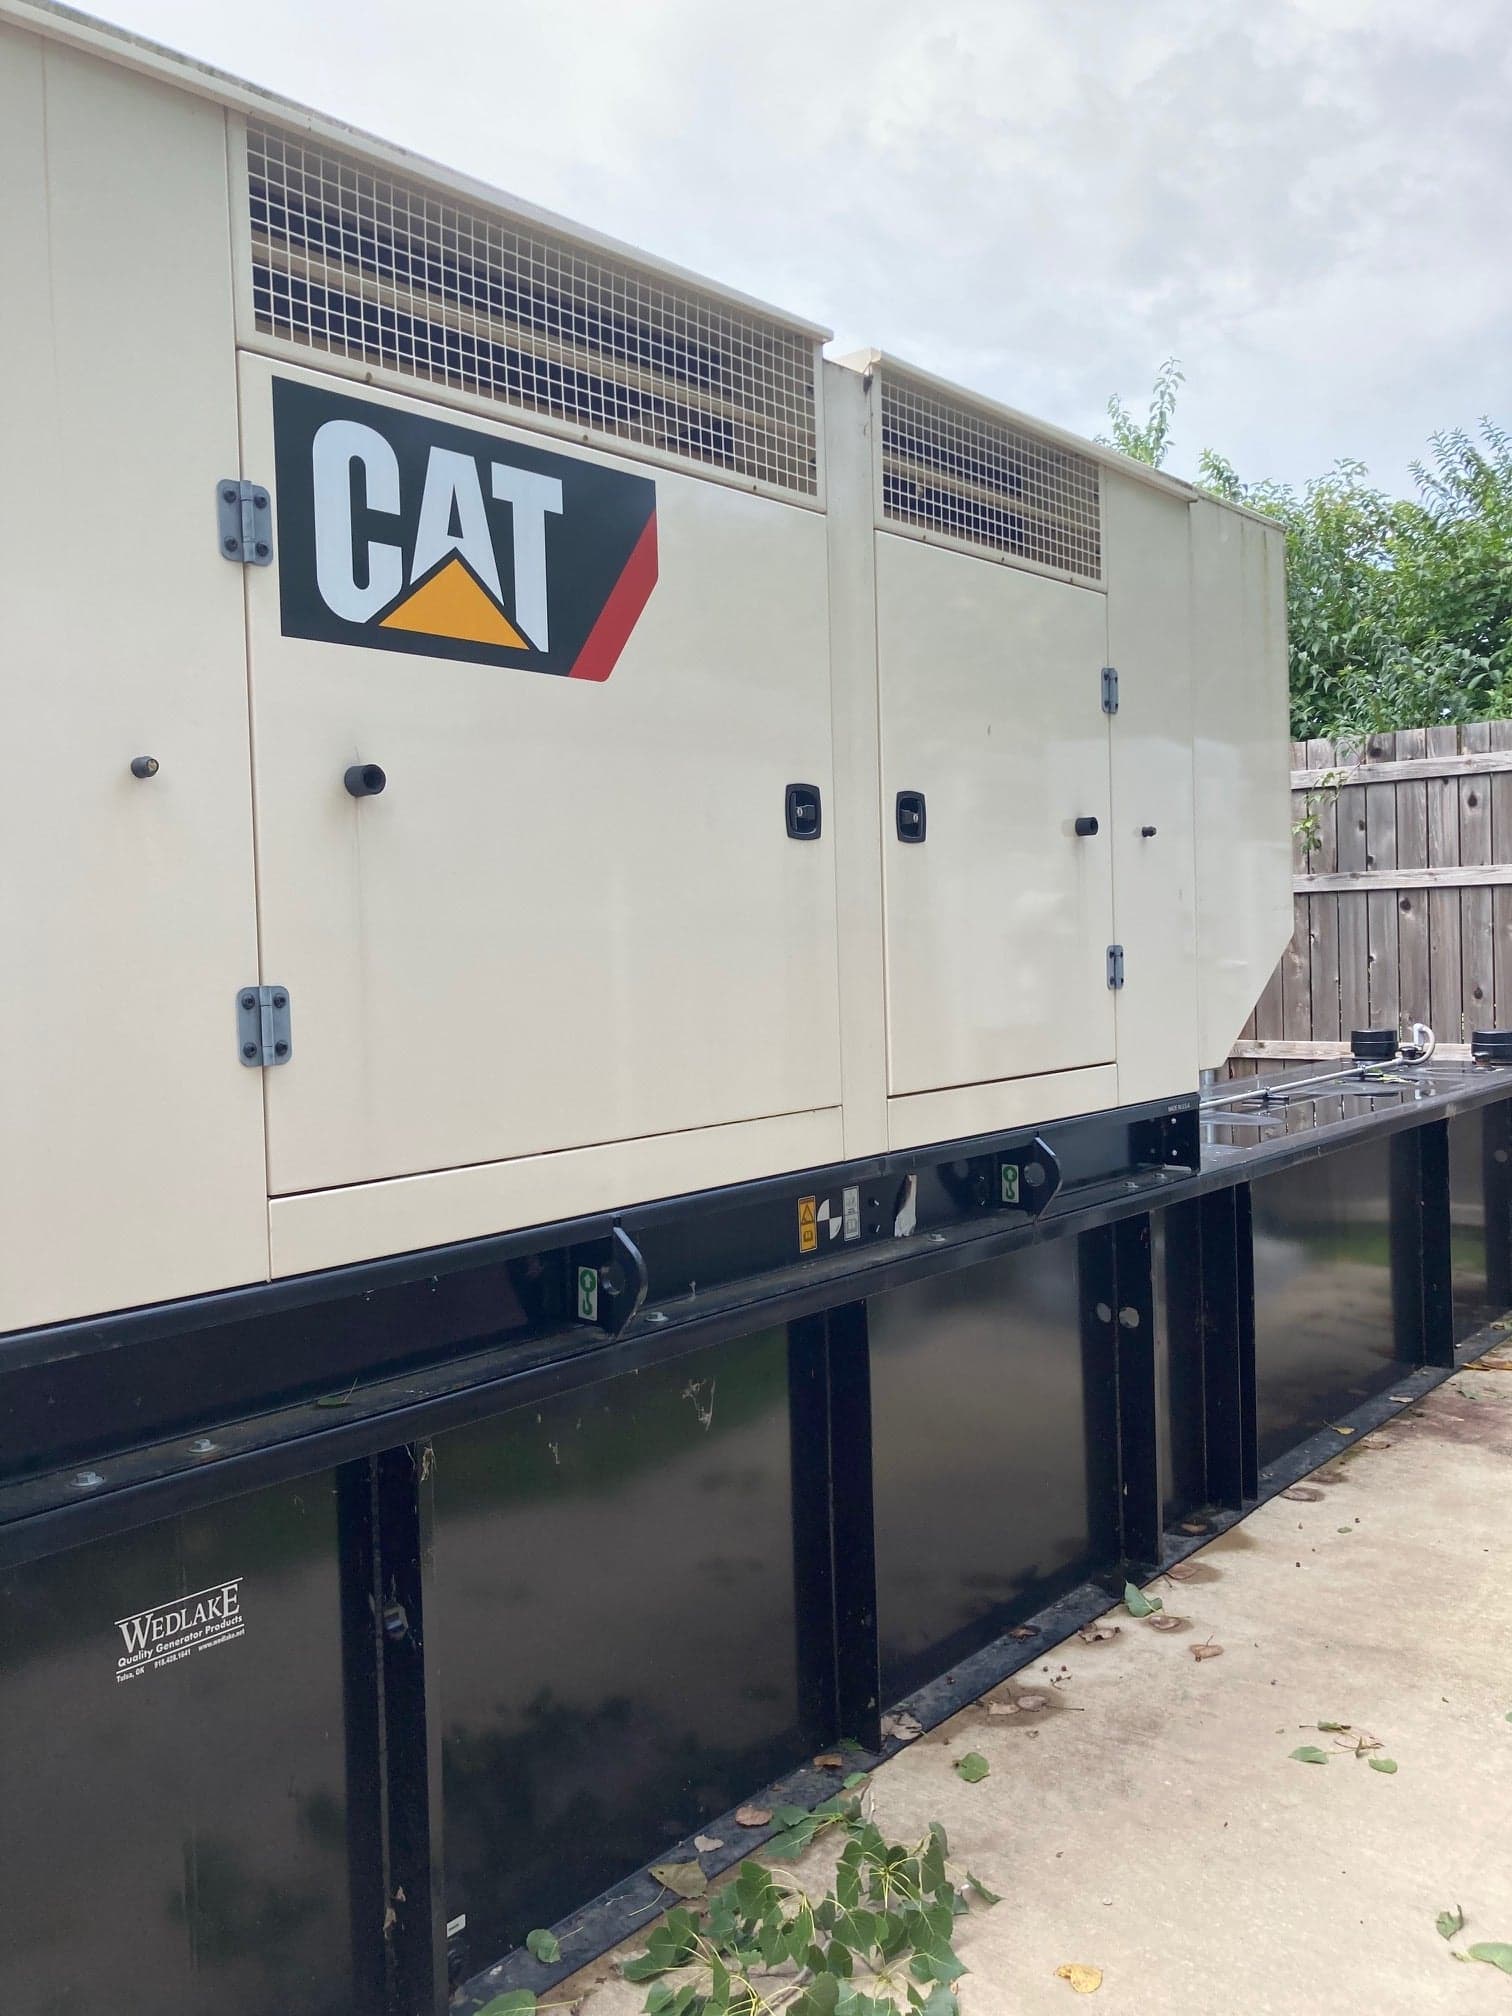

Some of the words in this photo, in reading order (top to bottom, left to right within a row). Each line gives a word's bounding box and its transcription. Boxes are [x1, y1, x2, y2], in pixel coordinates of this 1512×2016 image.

[312, 420, 563, 653] CAT
[118, 1648, 154, 1667] Quality
[155, 1631, 203, 1653] Generator
[205, 1615, 243, 1634] Products
[119, 1583, 240, 1654] WEDLAKE
[135, 1666, 145, 1676] OK
